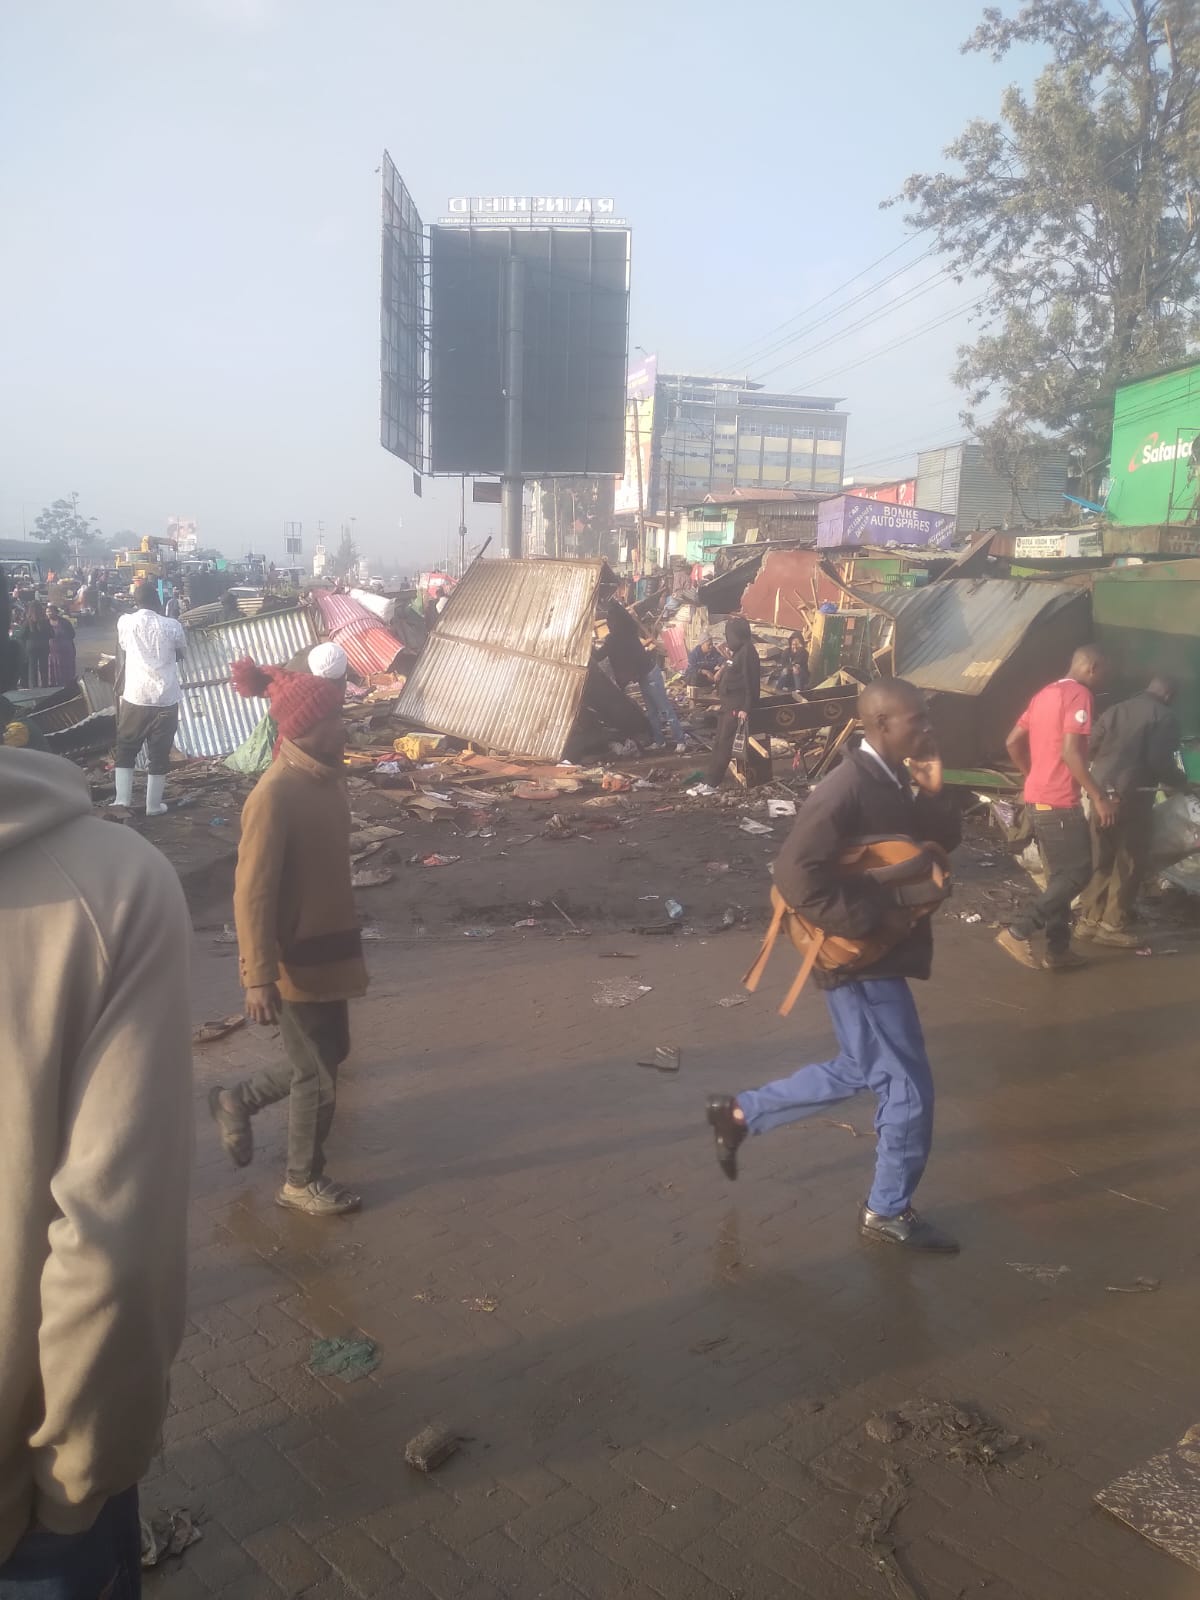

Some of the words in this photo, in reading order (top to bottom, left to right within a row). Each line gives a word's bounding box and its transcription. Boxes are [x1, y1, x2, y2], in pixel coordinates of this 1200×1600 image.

[883, 506, 920, 519] BONKE
[870, 515, 895, 528] AUTO
[895, 518, 931, 533] SPARES
